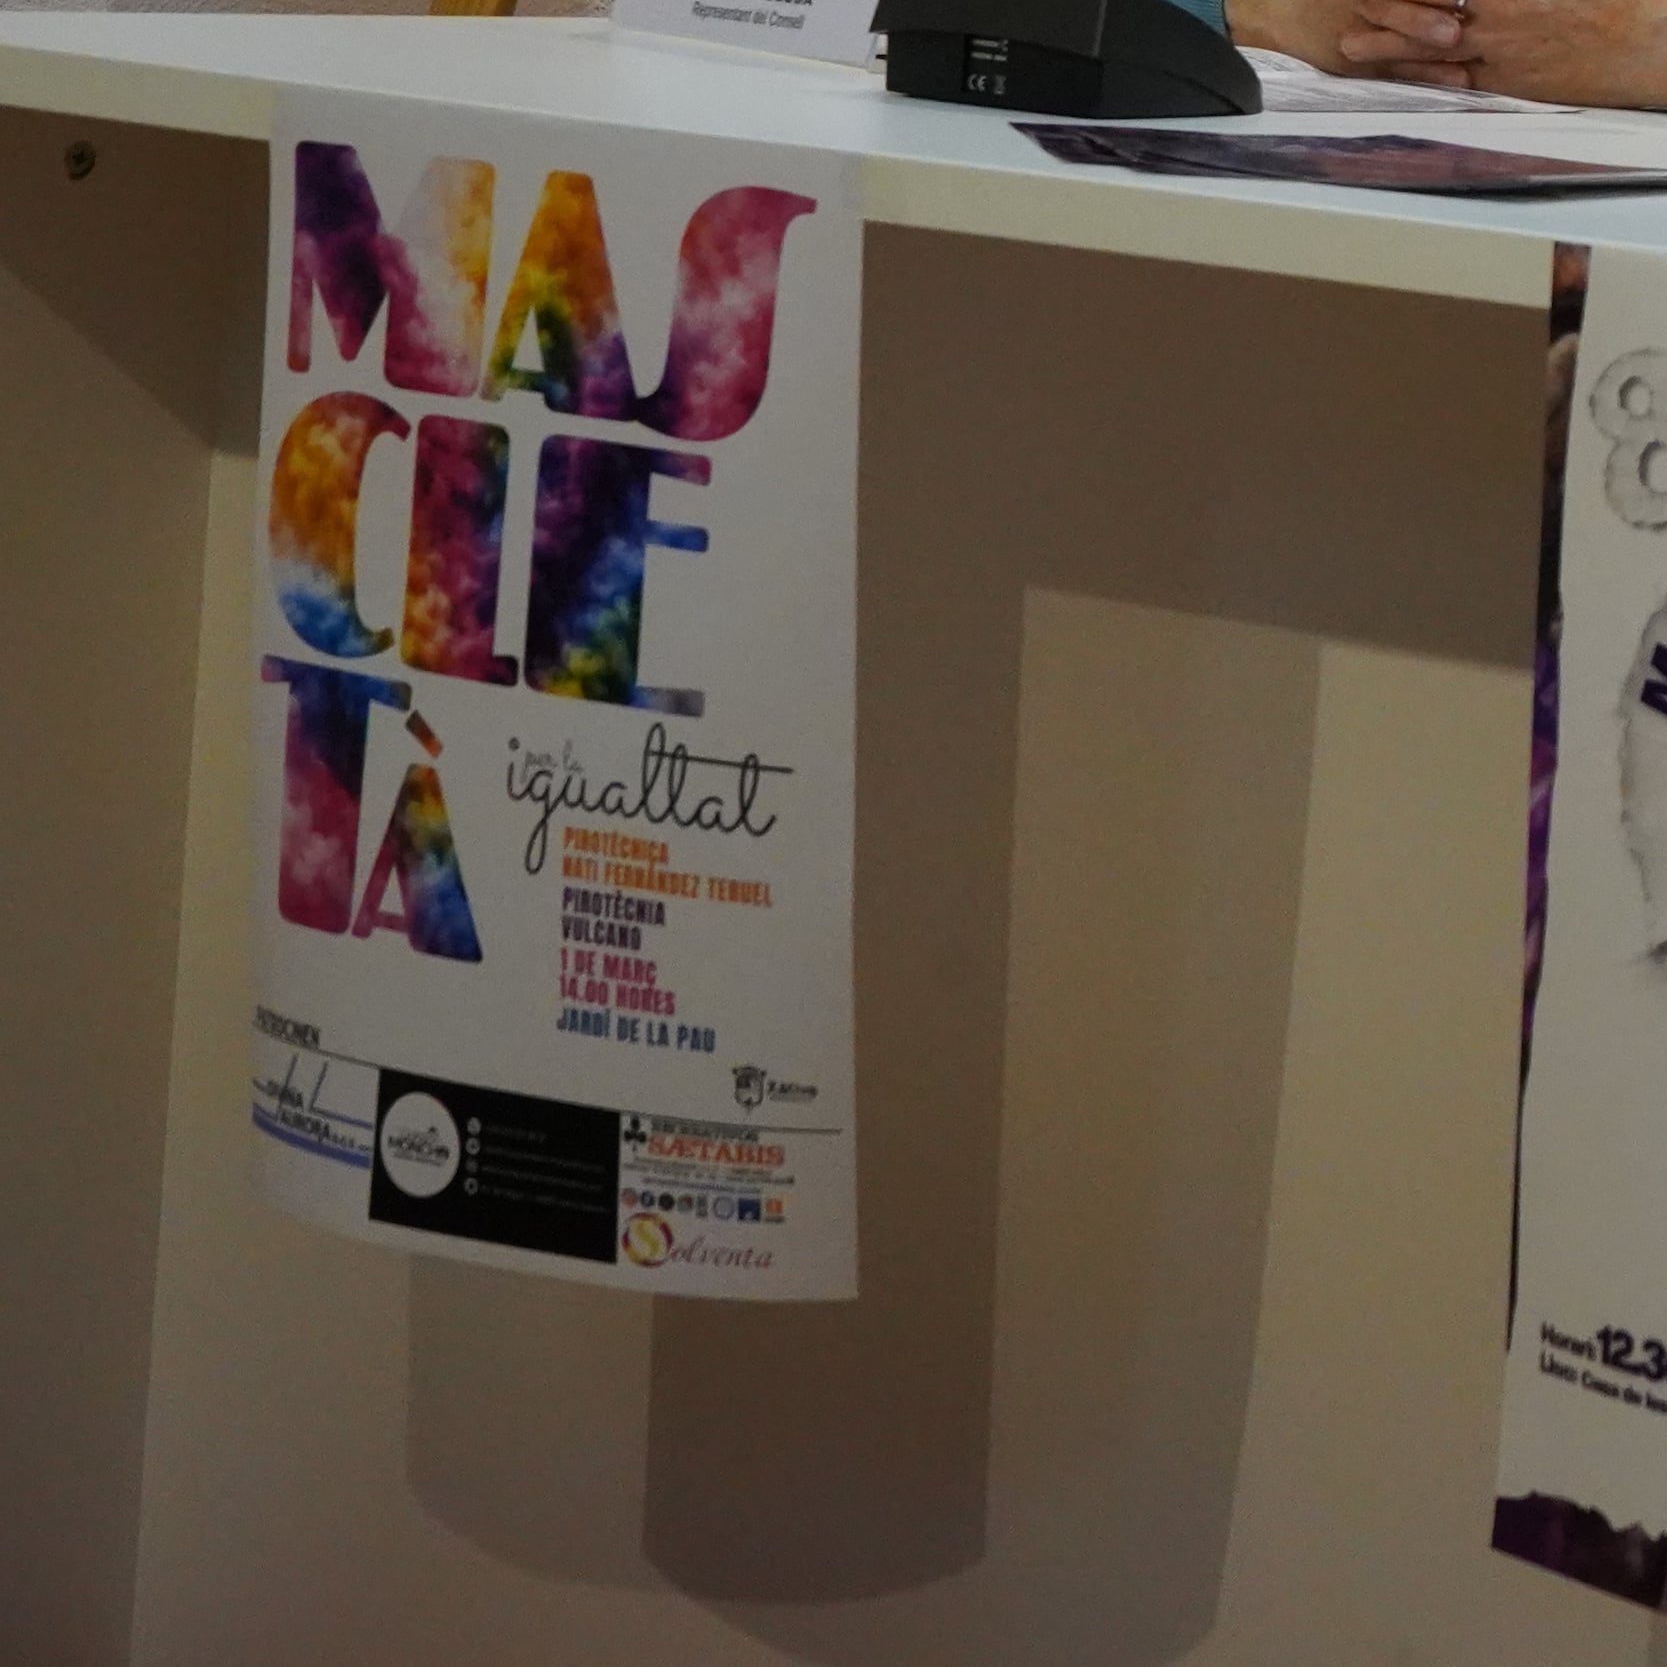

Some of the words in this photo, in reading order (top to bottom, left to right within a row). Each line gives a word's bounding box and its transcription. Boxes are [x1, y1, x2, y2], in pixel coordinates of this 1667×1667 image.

[287, 140, 818, 443] MAS
[267, 390, 712, 719] CLE
[260, 653, 484, 965] TÀ
[707, 875, 773, 908] TERUEL
[561, 916, 643, 952] VULCANO
[560, 947, 568, 971] 1
[574, 949, 596, 976] DE
[559, 975, 609, 1007] 14.00
[615, 985, 676, 1017] HORES
[617, 1013, 639, 1043] DE
[645, 1020, 670, 1047] LA
[676, 1025, 717, 1053] PAU
[1582, 1370, 1620, 1398] Casa
[1623, 1385, 1642, 1404] de
